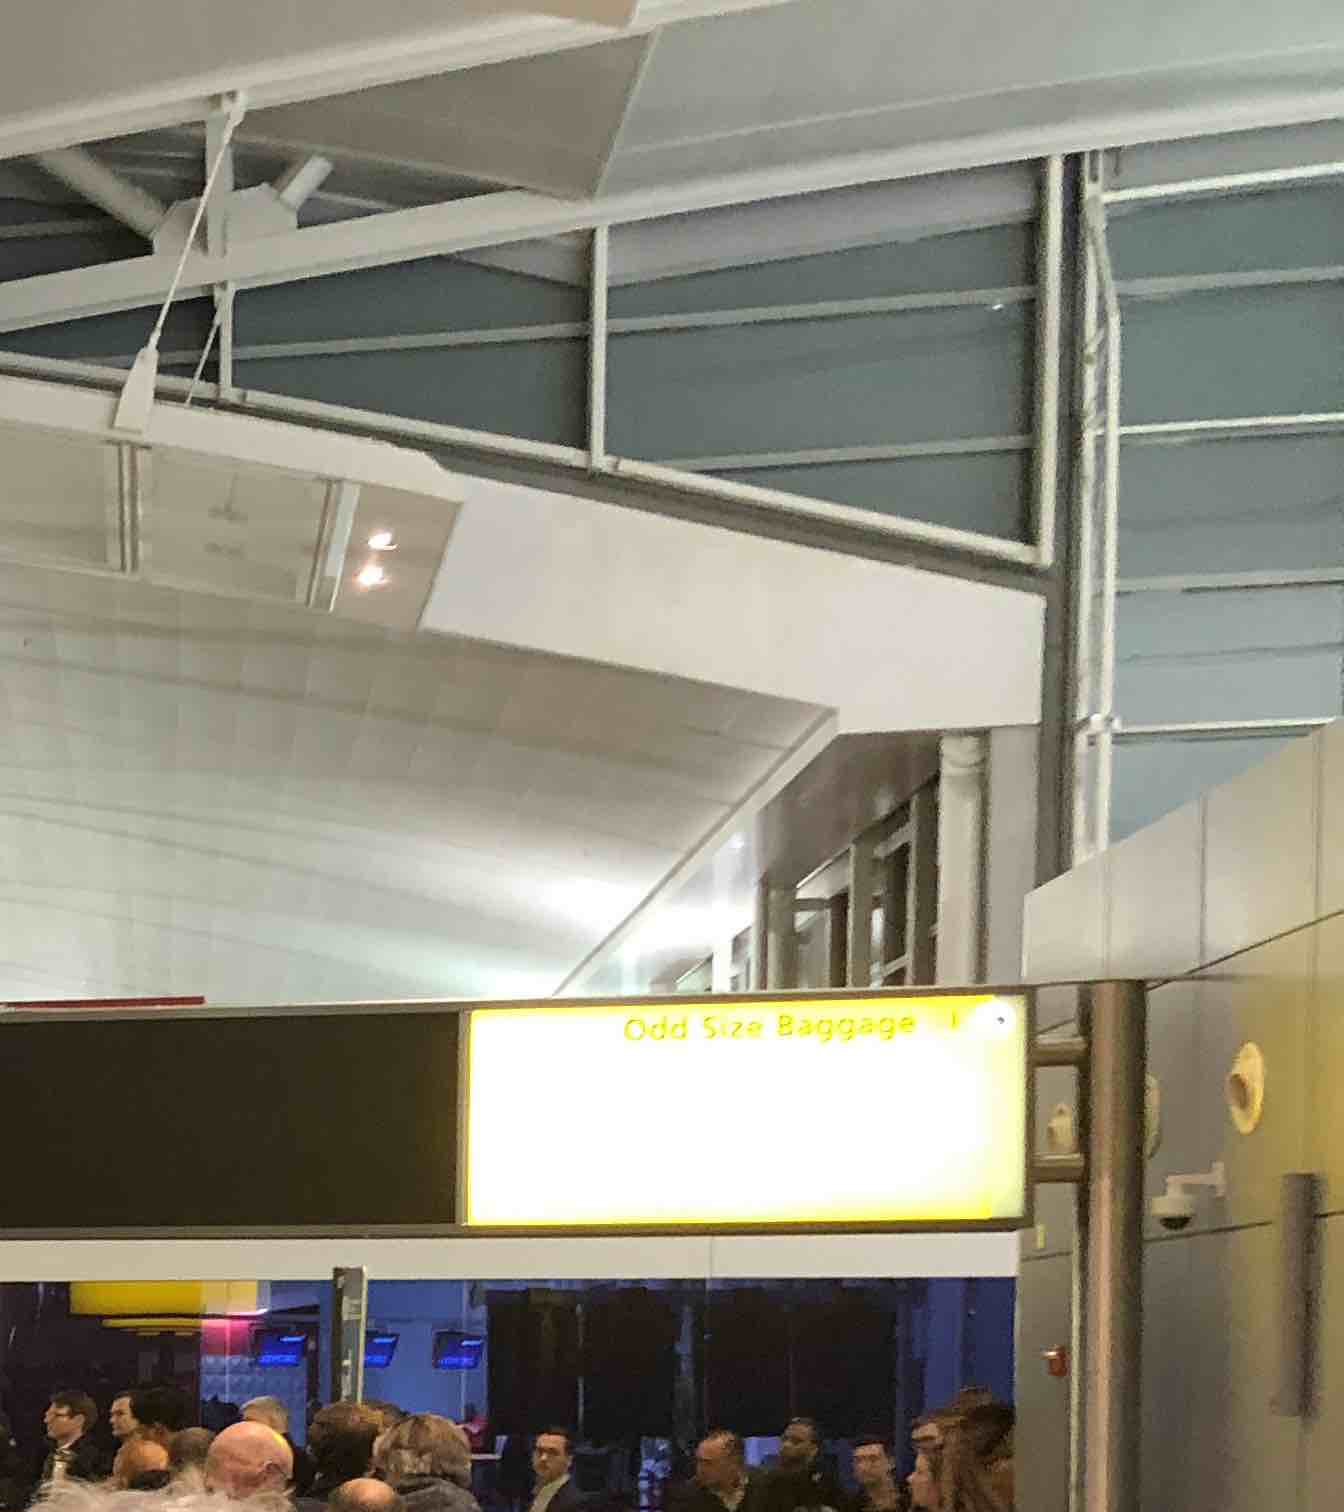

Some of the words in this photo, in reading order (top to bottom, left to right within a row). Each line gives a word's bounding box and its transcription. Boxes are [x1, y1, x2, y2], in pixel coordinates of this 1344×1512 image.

[623, 1015, 690, 1041] Odd
[703, 1014, 765, 1040] Size
[777, 1013, 915, 1043] Baggage
